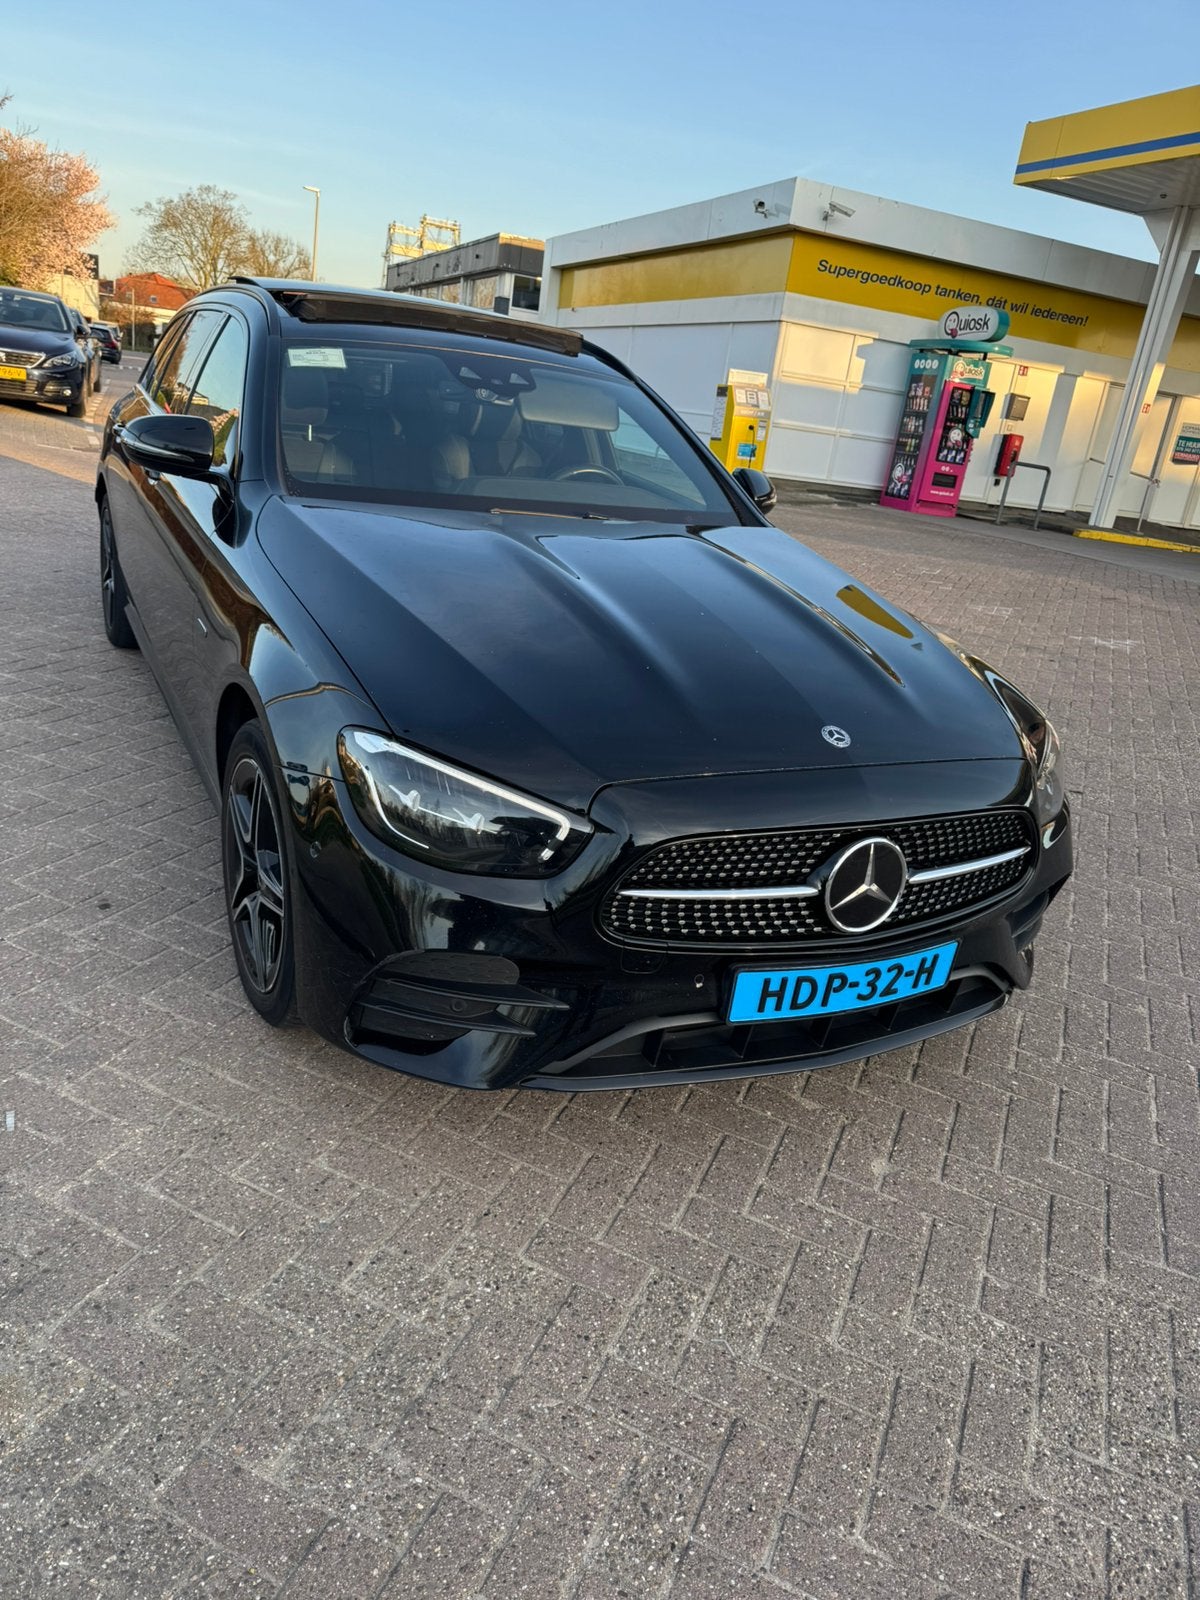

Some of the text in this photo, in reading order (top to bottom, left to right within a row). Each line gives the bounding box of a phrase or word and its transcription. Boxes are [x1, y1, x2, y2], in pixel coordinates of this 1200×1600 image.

[817, 260, 1089, 326] Supergoedkoop tanken, dát wil iedereen!
[944, 311, 991, 338] Quiosk
[955, 361, 984, 377] Quiosk
[757, 954, 940, 1013] HDP-32-H
